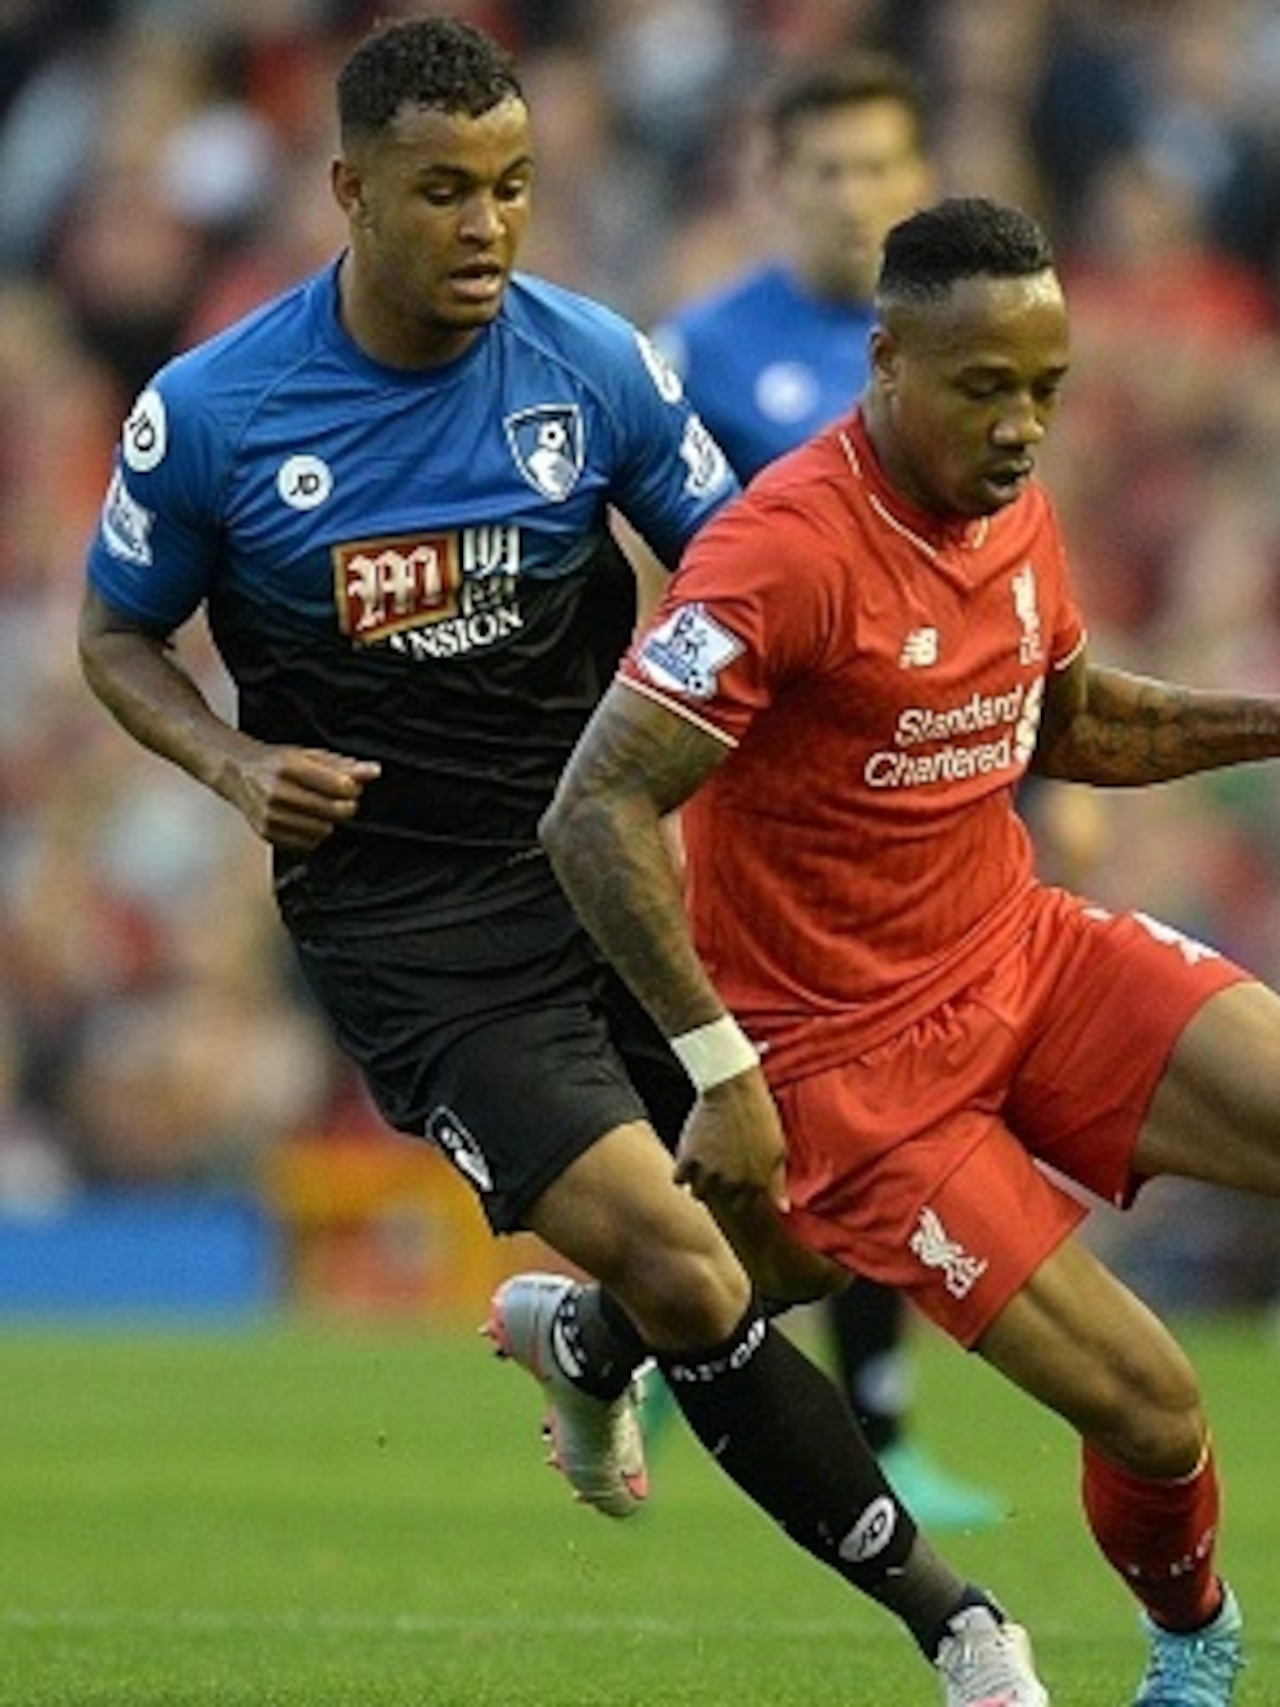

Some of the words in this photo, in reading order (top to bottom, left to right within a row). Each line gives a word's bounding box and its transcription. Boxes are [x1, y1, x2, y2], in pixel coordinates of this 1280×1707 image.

[289, 473, 321, 497] JD
[894, 684, 1024, 747] Standard
[863, 736, 1012, 788] Chartered
